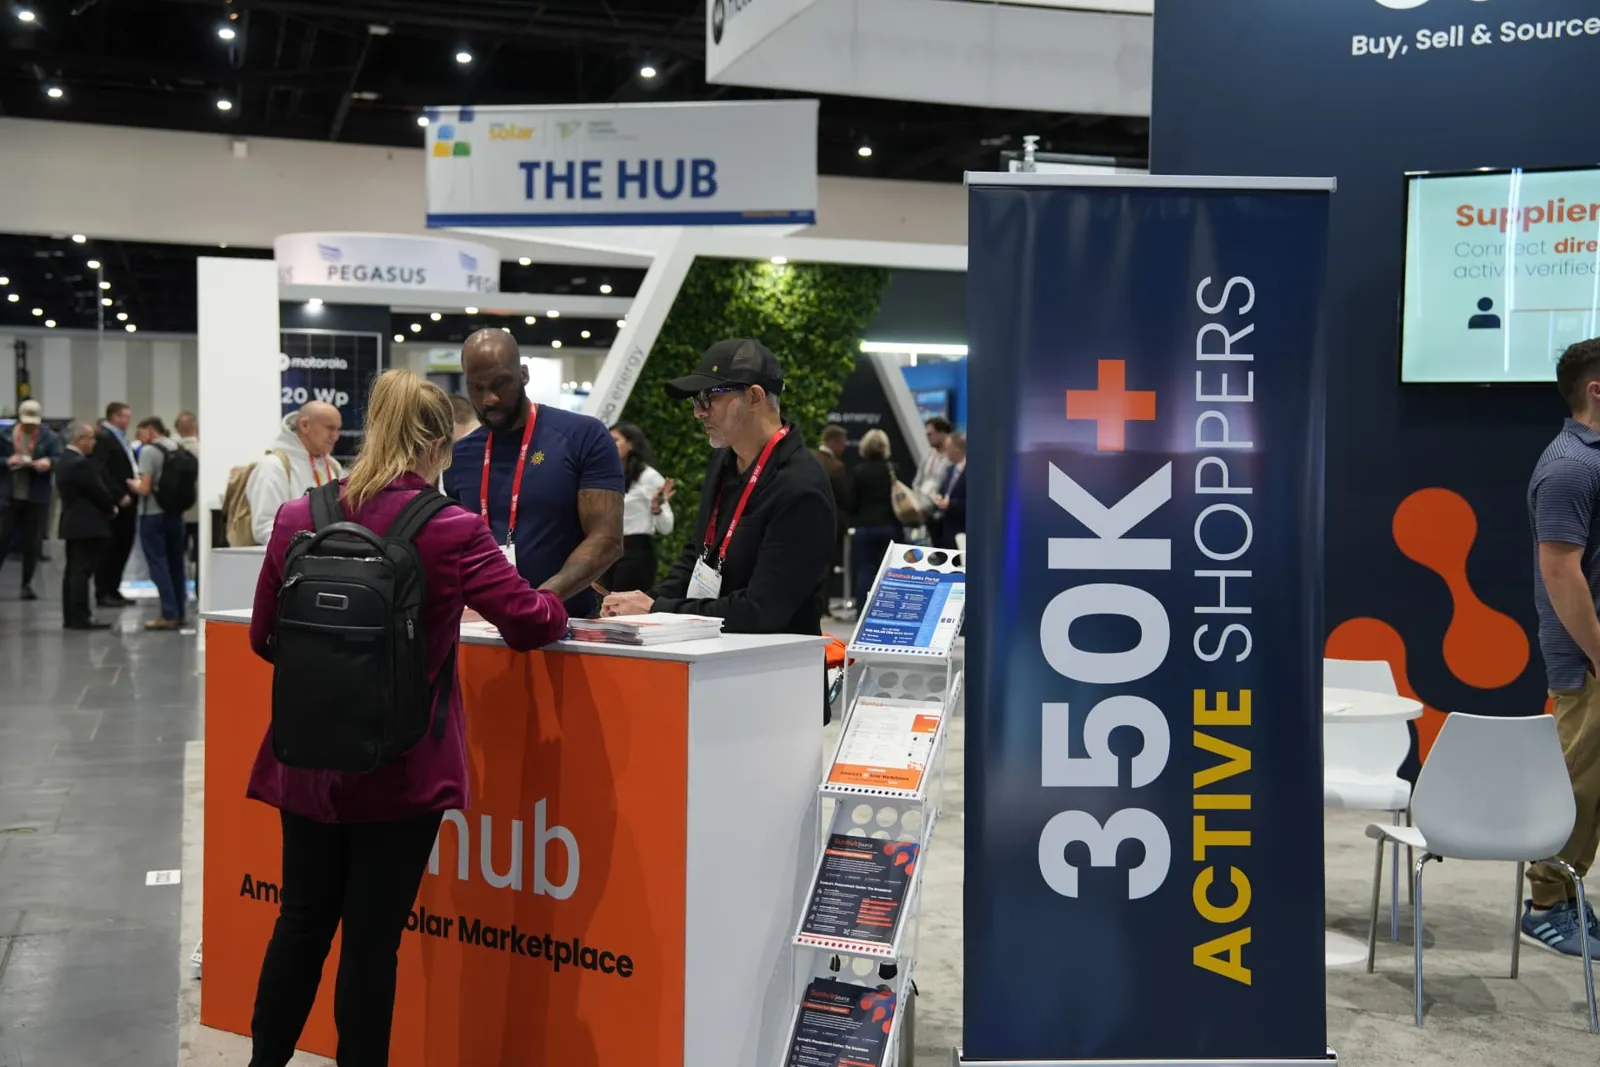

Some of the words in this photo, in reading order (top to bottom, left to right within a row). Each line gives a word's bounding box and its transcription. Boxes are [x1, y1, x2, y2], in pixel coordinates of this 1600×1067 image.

[1352, 35, 1408, 60] Buy,
[1416, 25, 1464, 50] Sell
[1471, 24, 1493, 45] &
[1500, 16, 1600, 43] Source
[518, 160, 602, 200] THE
[617, 158, 718, 200] HUB
[327, 265, 427, 284] PEGASUS
[1453, 262, 1519, 279] activ
[291, 356, 348, 370] motorola
[313, 388, 349, 408] Wp
[1193, 275, 1256, 662] SHOPPERS
[1038, 359, 1172, 900] 350K+
[1193, 689, 1252, 986] ACTIVE
[404, 905, 453, 938] olar
[458, 915, 634, 978] Marketplace
